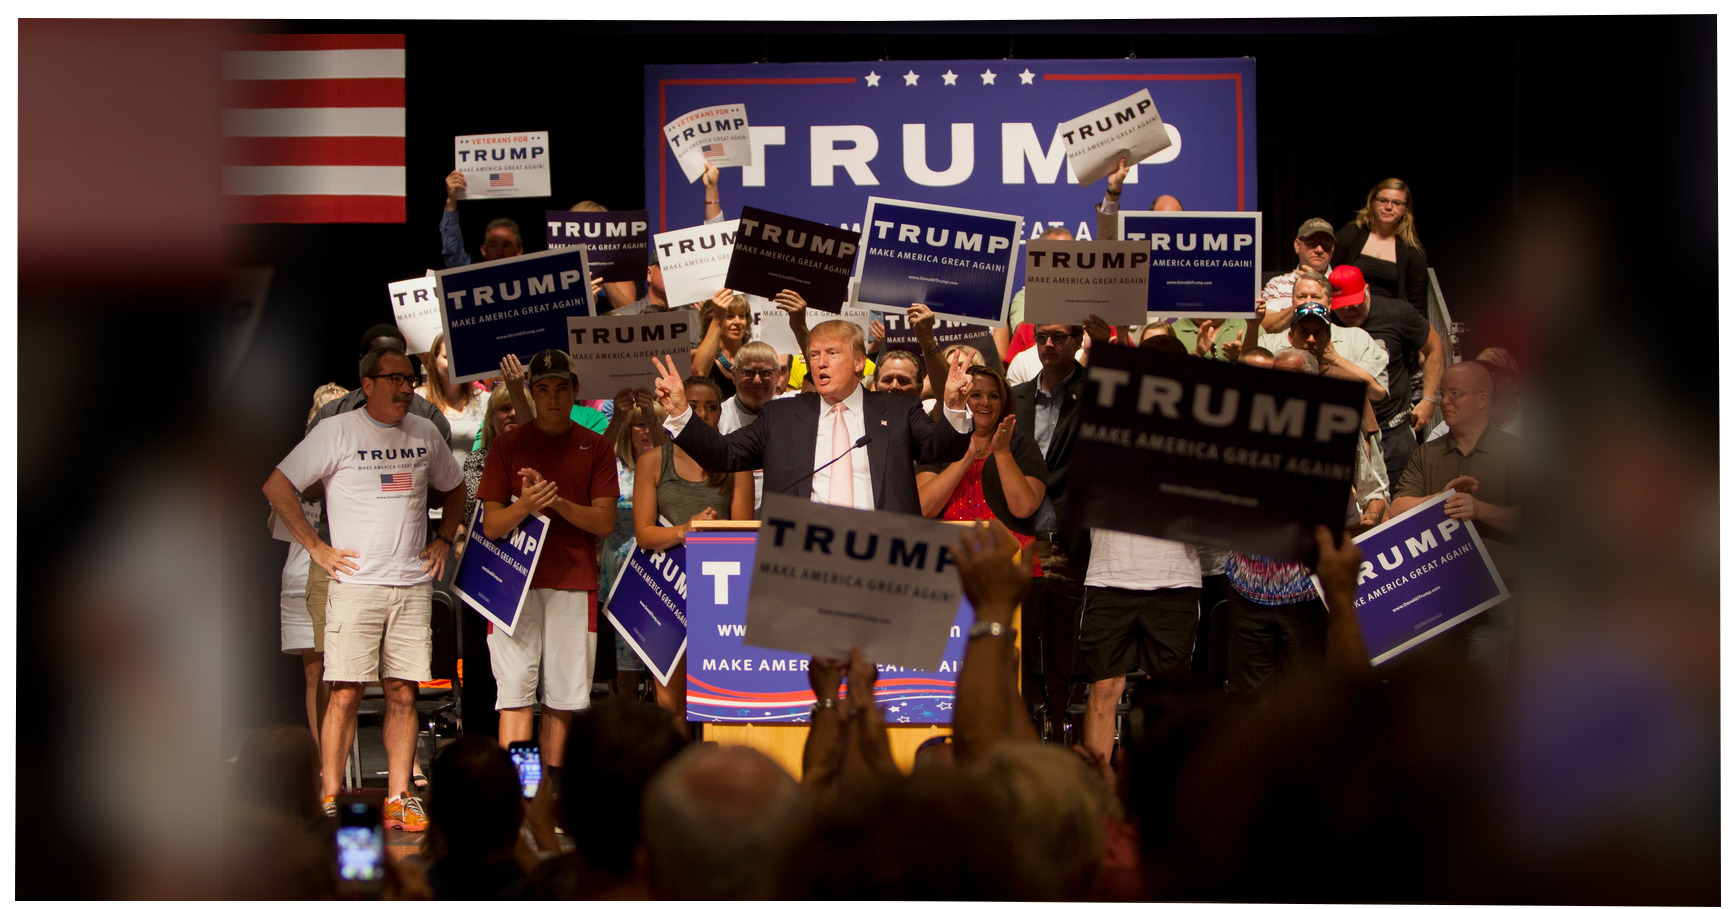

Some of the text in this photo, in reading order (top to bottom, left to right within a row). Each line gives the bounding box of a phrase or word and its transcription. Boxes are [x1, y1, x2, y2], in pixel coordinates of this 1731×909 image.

[676, 110, 714, 127] VETERANS
[1063, 99, 1151, 145] TRUMP
[671, 118, 744, 147] TRUMP
[689, 138, 712, 150] AMERICA
[1068, 116, 1159, 158] MAKE AMERICA GREAT AGAIN!
[458, 146, 544, 162] TRUMP
[548, 221, 648, 238] TRUMP
[742, 218, 857, 259] TRUMP
[874, 220, 1010, 254] TRUMP
[1128, 233, 1253, 252] TRUMP
[622, 242, 647, 250] AGAIN!
[658, 231, 738, 257] TRUM
[663, 253, 732, 272] MAKE AMERICA GRE
[736, 243, 850, 276] MAKE AMERICA GREAT AGAIN!
[869, 247, 1006, 272] MAKE AMERICA GREAT AGAIN!
[1029, 251, 1148, 269] TRUMP
[1222, 260, 1252, 268] AGAIN!
[394, 288, 438, 306] TR
[447, 270, 581, 310] TRUMP
[398, 308, 438, 320] MAKE AMER
[451, 297, 584, 328] MAKE AMERICA GREAT AGAIN!
[570, 322, 688, 344] TRUMP
[940, 334, 962, 342] GREAT
[964, 330, 988, 340] AGAIN!
[634, 350, 658, 358] GREAT
[661, 346, 689, 356] AGAIN!
[1088, 366, 1361, 444] TRUMP
[358, 448, 426, 460] TRUMP
[1078, 422, 1352, 482] MAKE AMERICA GREAT AGAIN!
[471, 530, 483, 544] MAKE
[482, 538, 501, 558] AMERICA
[500, 551, 514, 568] GREAT
[512, 560, 528, 577] AGAIN!
[1356, 517, 1460, 586] RUMP
[640, 549, 687, 600] RUM
[759, 562, 956, 603] MAKE AMERICA GREAT AGAIN!
[1368, 576, 1409, 602] AMERICA
[1410, 561, 1439, 580] GREAT
[1440, 542, 1473, 564] AGAIN!
[630, 558, 643, 578] MAKE
[642, 572, 662, 598] AMERICA
[661, 592, 676, 613] GREAT
[674, 606, 687, 627] AGAI
[1392, 585, 1441, 612] www.DonaldTrump.com
[702, 659, 810, 671] MAKE AMER
